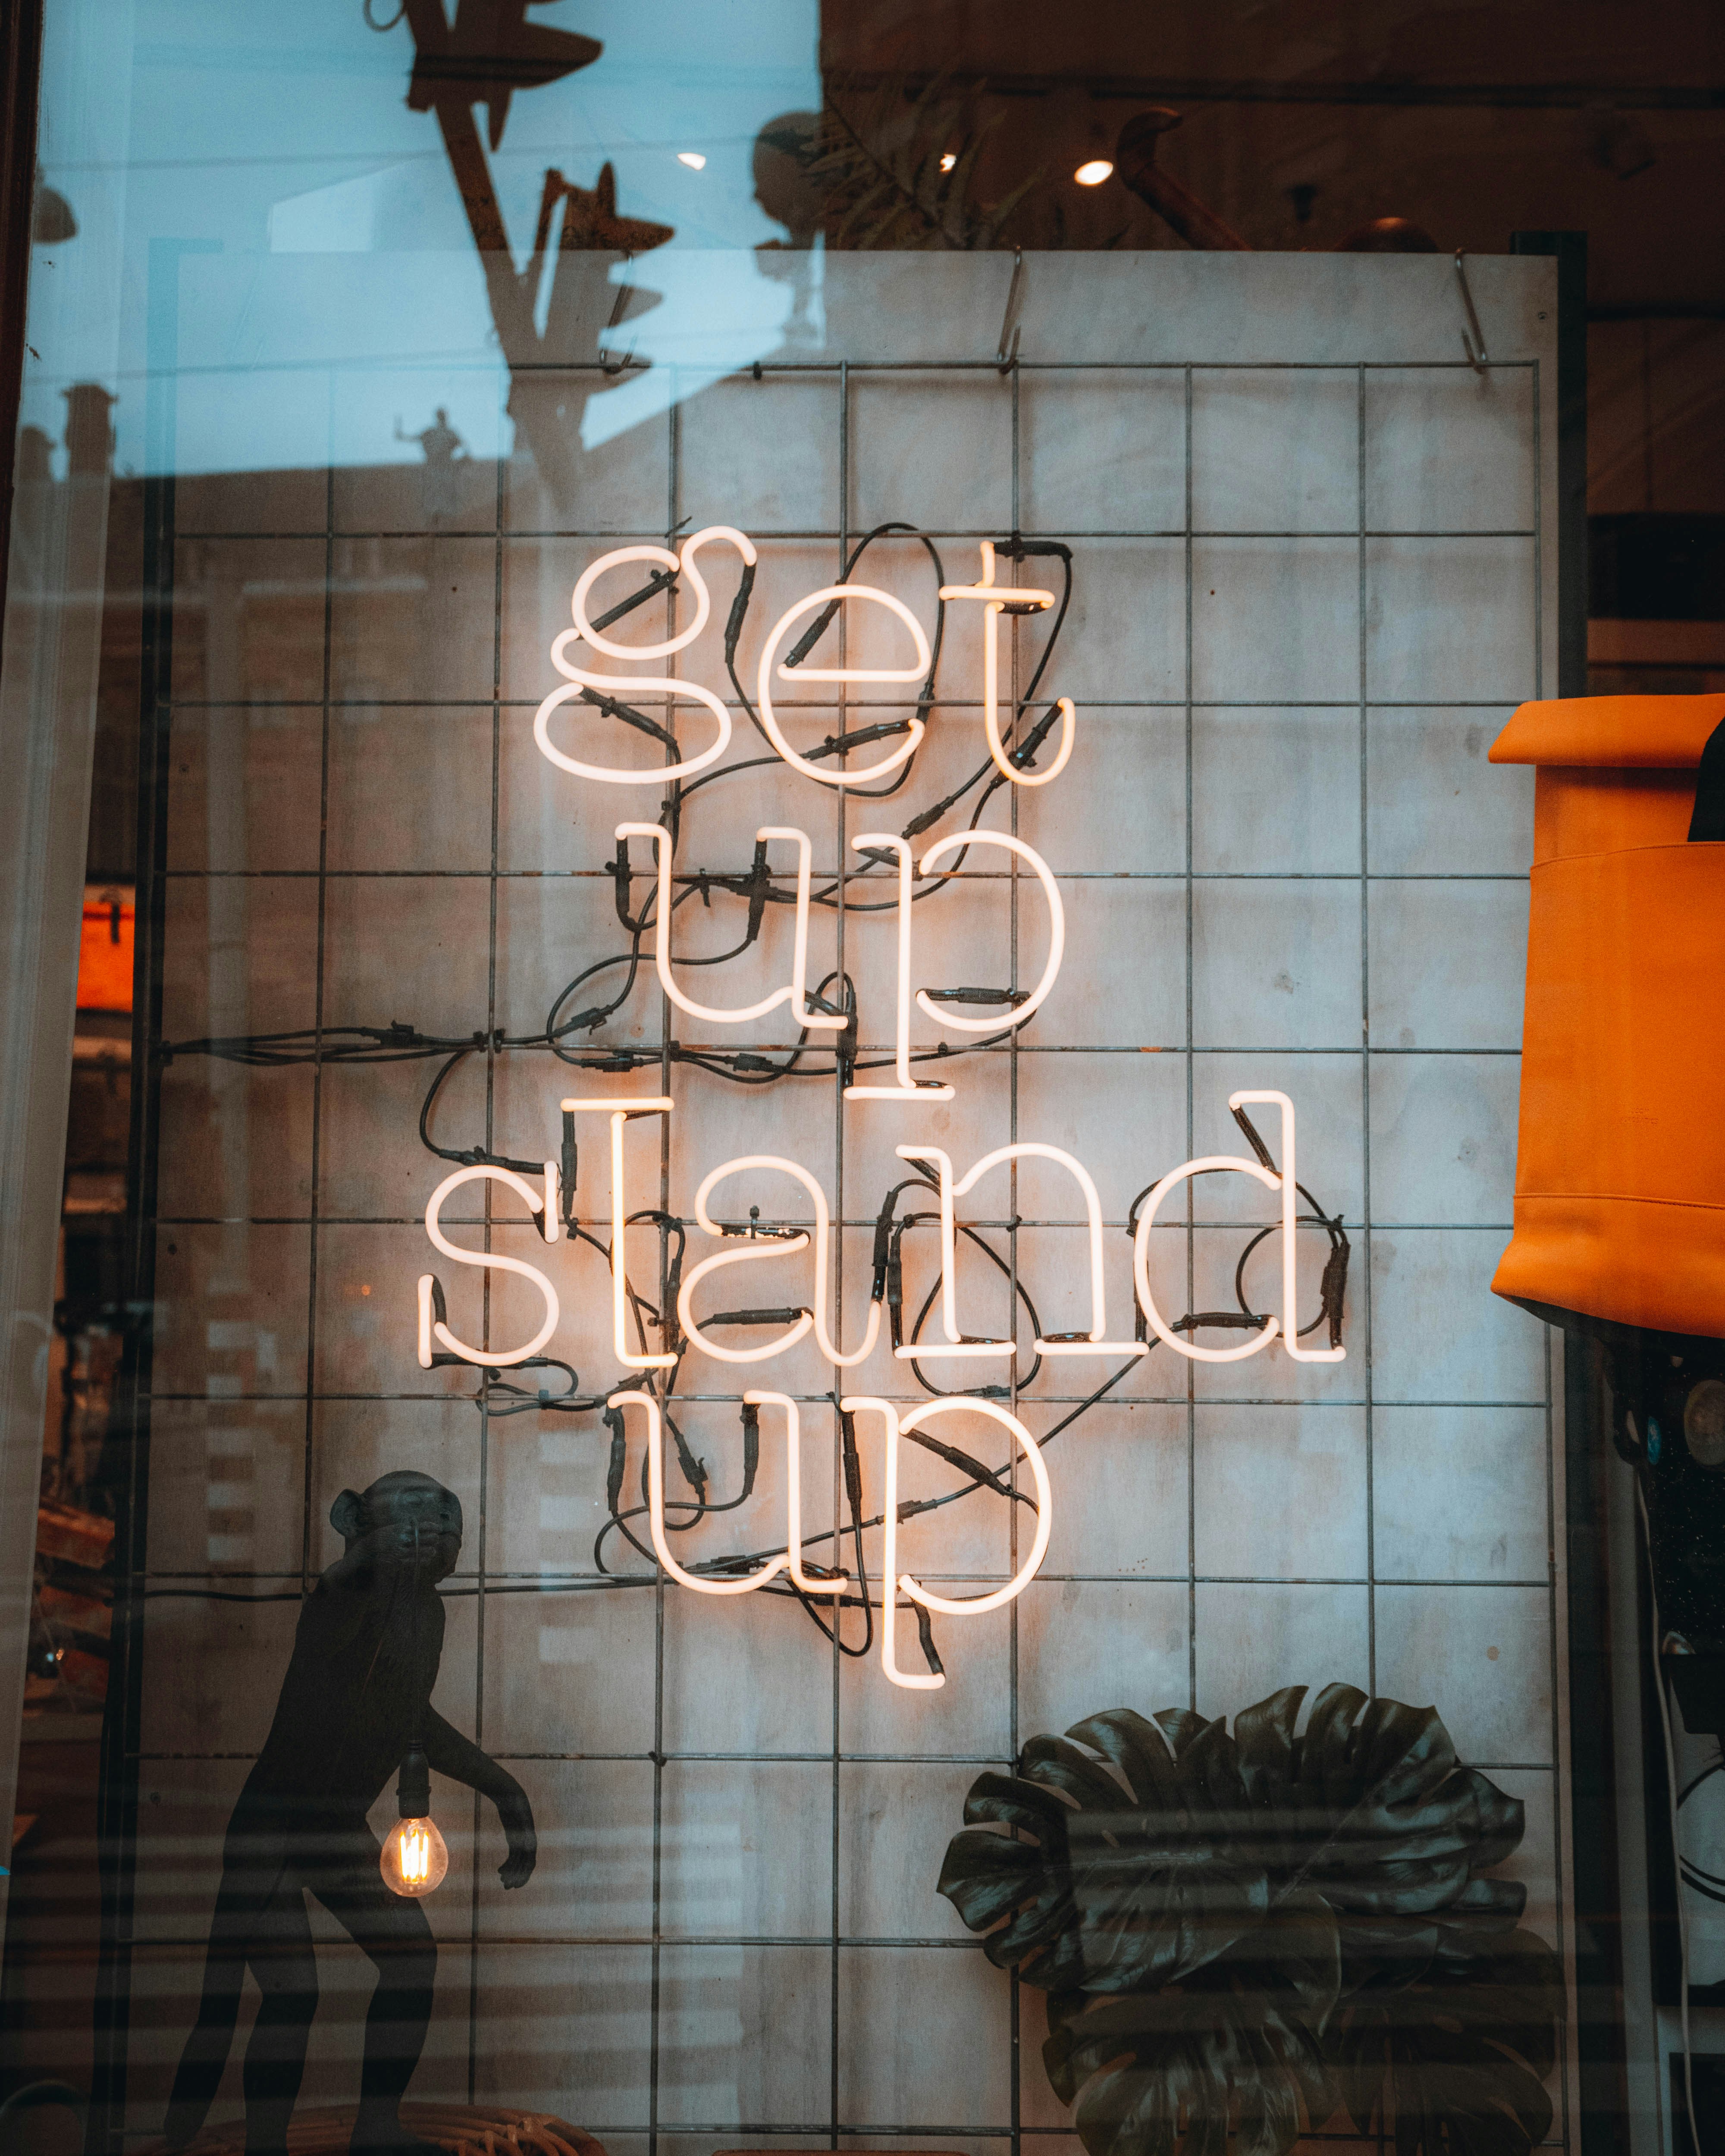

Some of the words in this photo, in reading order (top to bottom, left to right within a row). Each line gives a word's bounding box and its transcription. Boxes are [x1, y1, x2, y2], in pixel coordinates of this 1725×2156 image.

[533, 525, 1076, 786] get
[614, 821, 1066, 1103] up
[417, 1089, 1347, 1367] stand
[607, 1389, 1053, 1691] up
